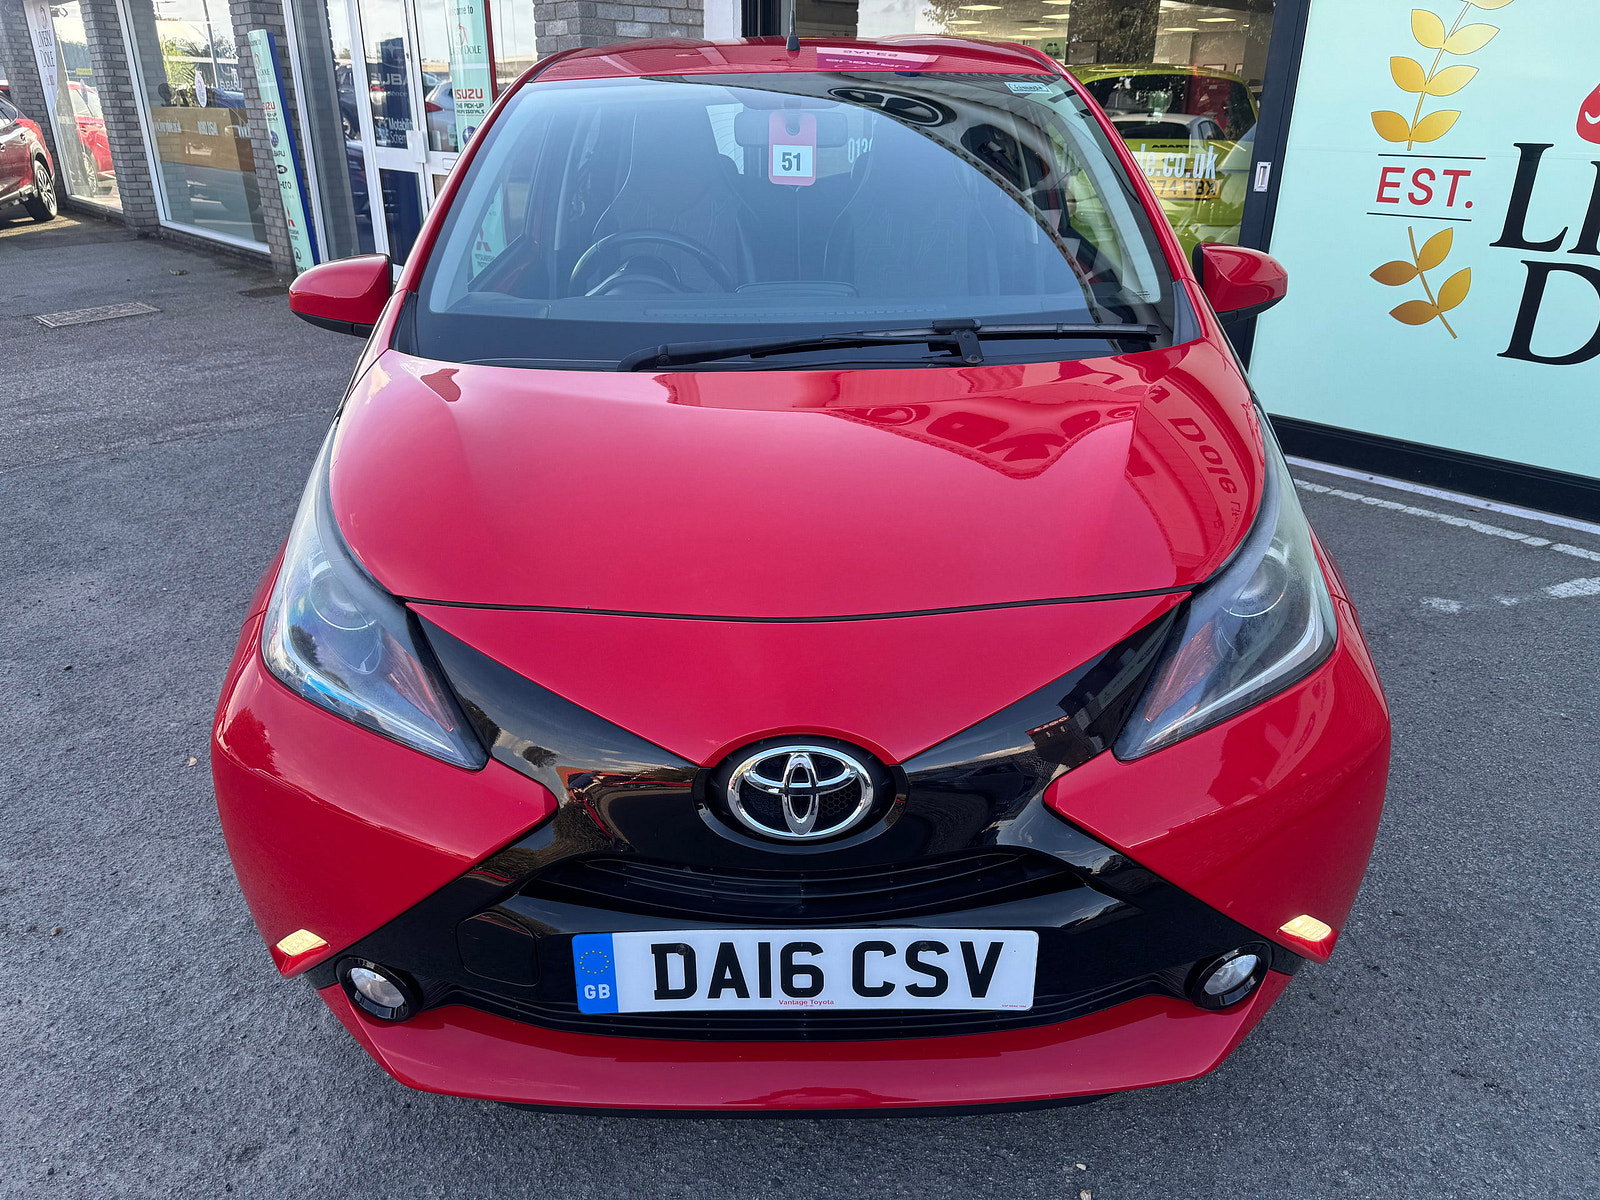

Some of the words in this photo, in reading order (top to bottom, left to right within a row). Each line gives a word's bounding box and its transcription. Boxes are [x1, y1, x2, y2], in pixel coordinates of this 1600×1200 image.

[454, 88, 484, 99] ISUZU
[781, 151, 802, 172] 51
[1375, 166, 1473, 209] EST.
[650, 940, 825, 1000] DA16
[851, 939, 1005, 998] CSV
[583, 983, 611, 999] GB
